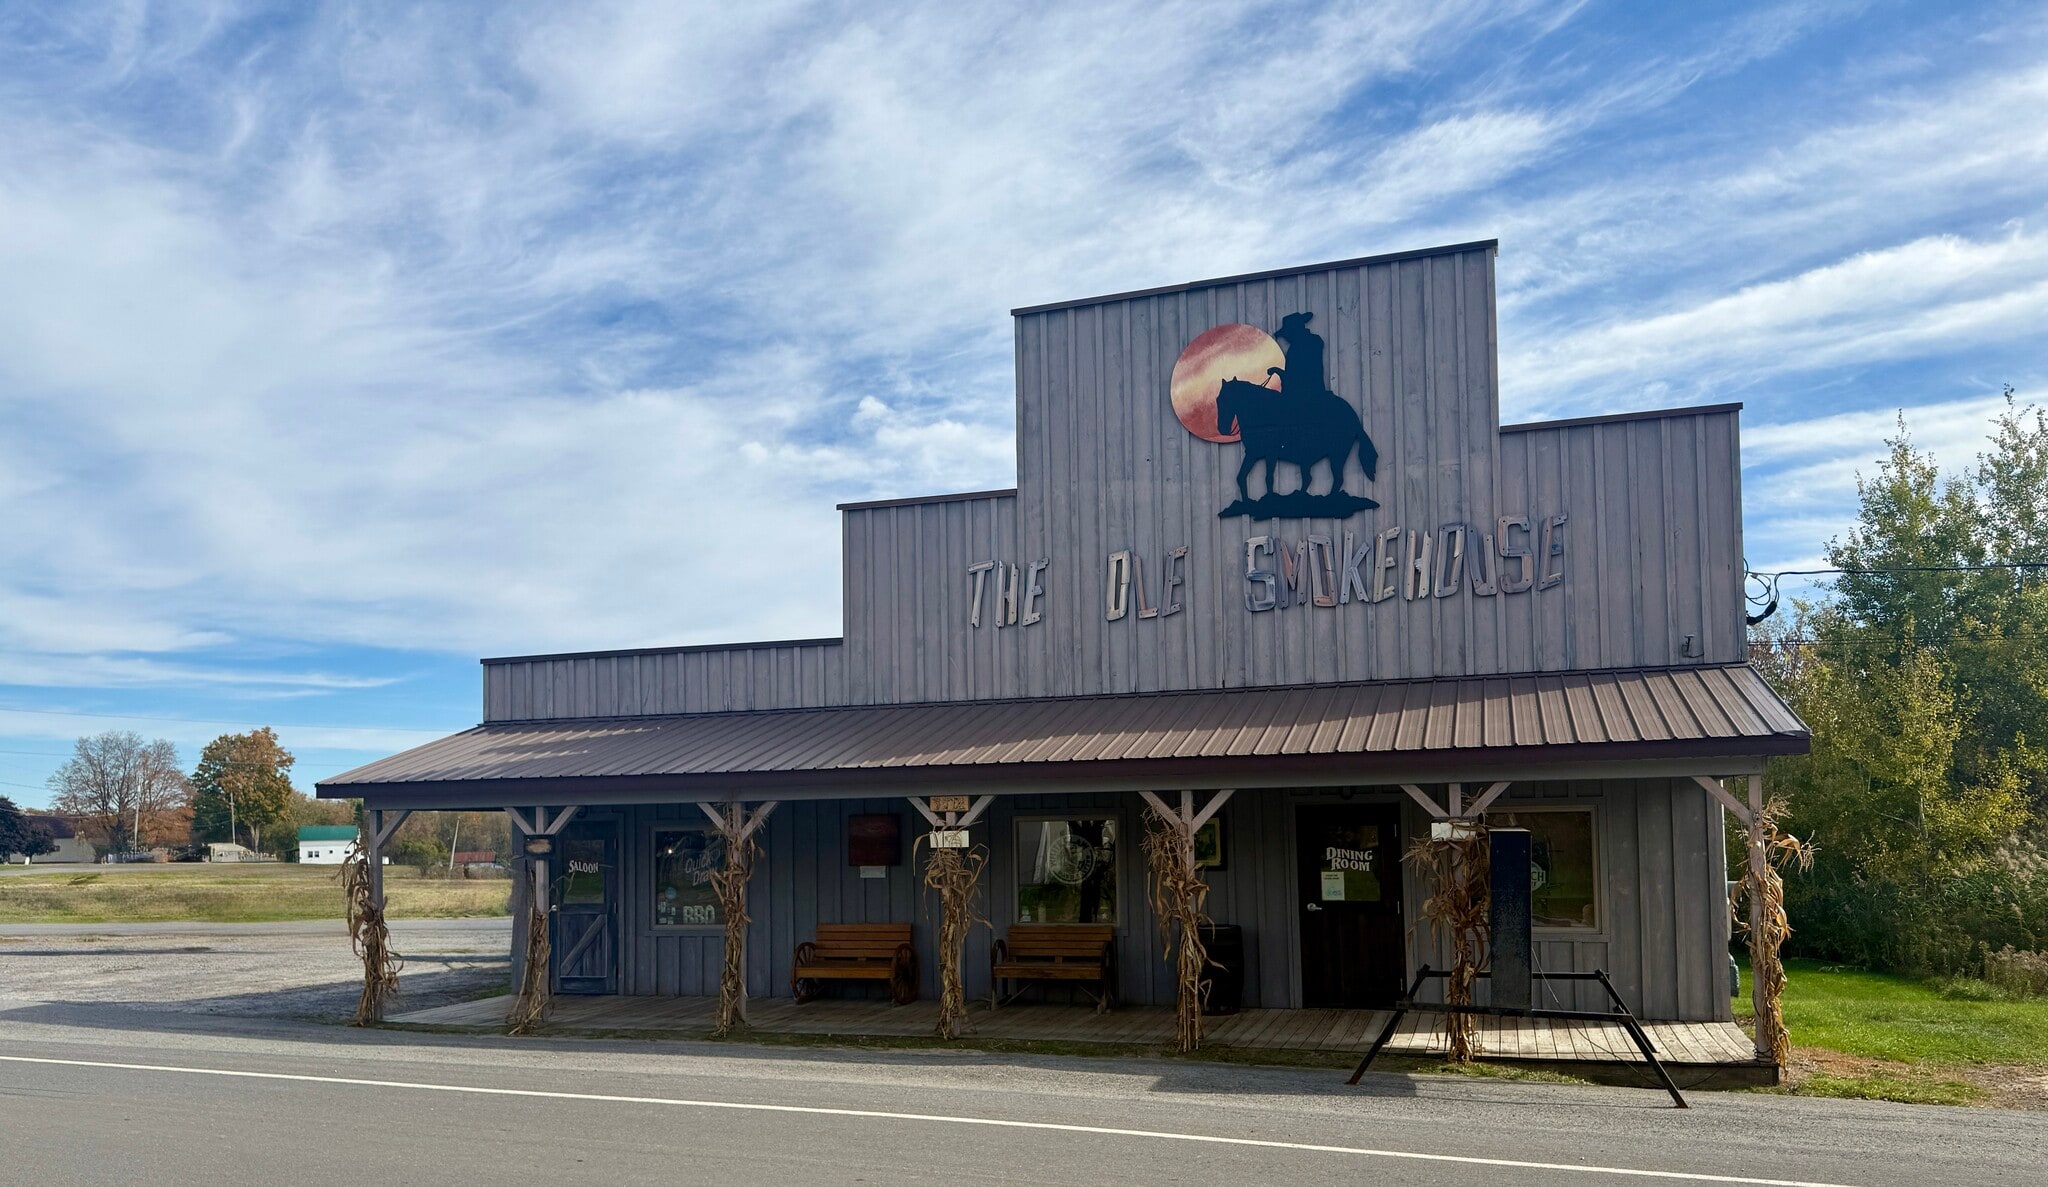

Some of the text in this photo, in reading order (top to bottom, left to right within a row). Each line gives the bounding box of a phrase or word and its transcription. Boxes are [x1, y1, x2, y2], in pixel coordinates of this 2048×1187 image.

[967, 512, 1569, 628] THE OLE SMOKEHOUSE
[685, 851, 713, 873] Quick
[1326, 846, 1373, 861] DINING
[568, 859, 599, 874] SALOON
[1331, 857, 1370, 872] ROOM
[692, 868, 713, 887] Dra
